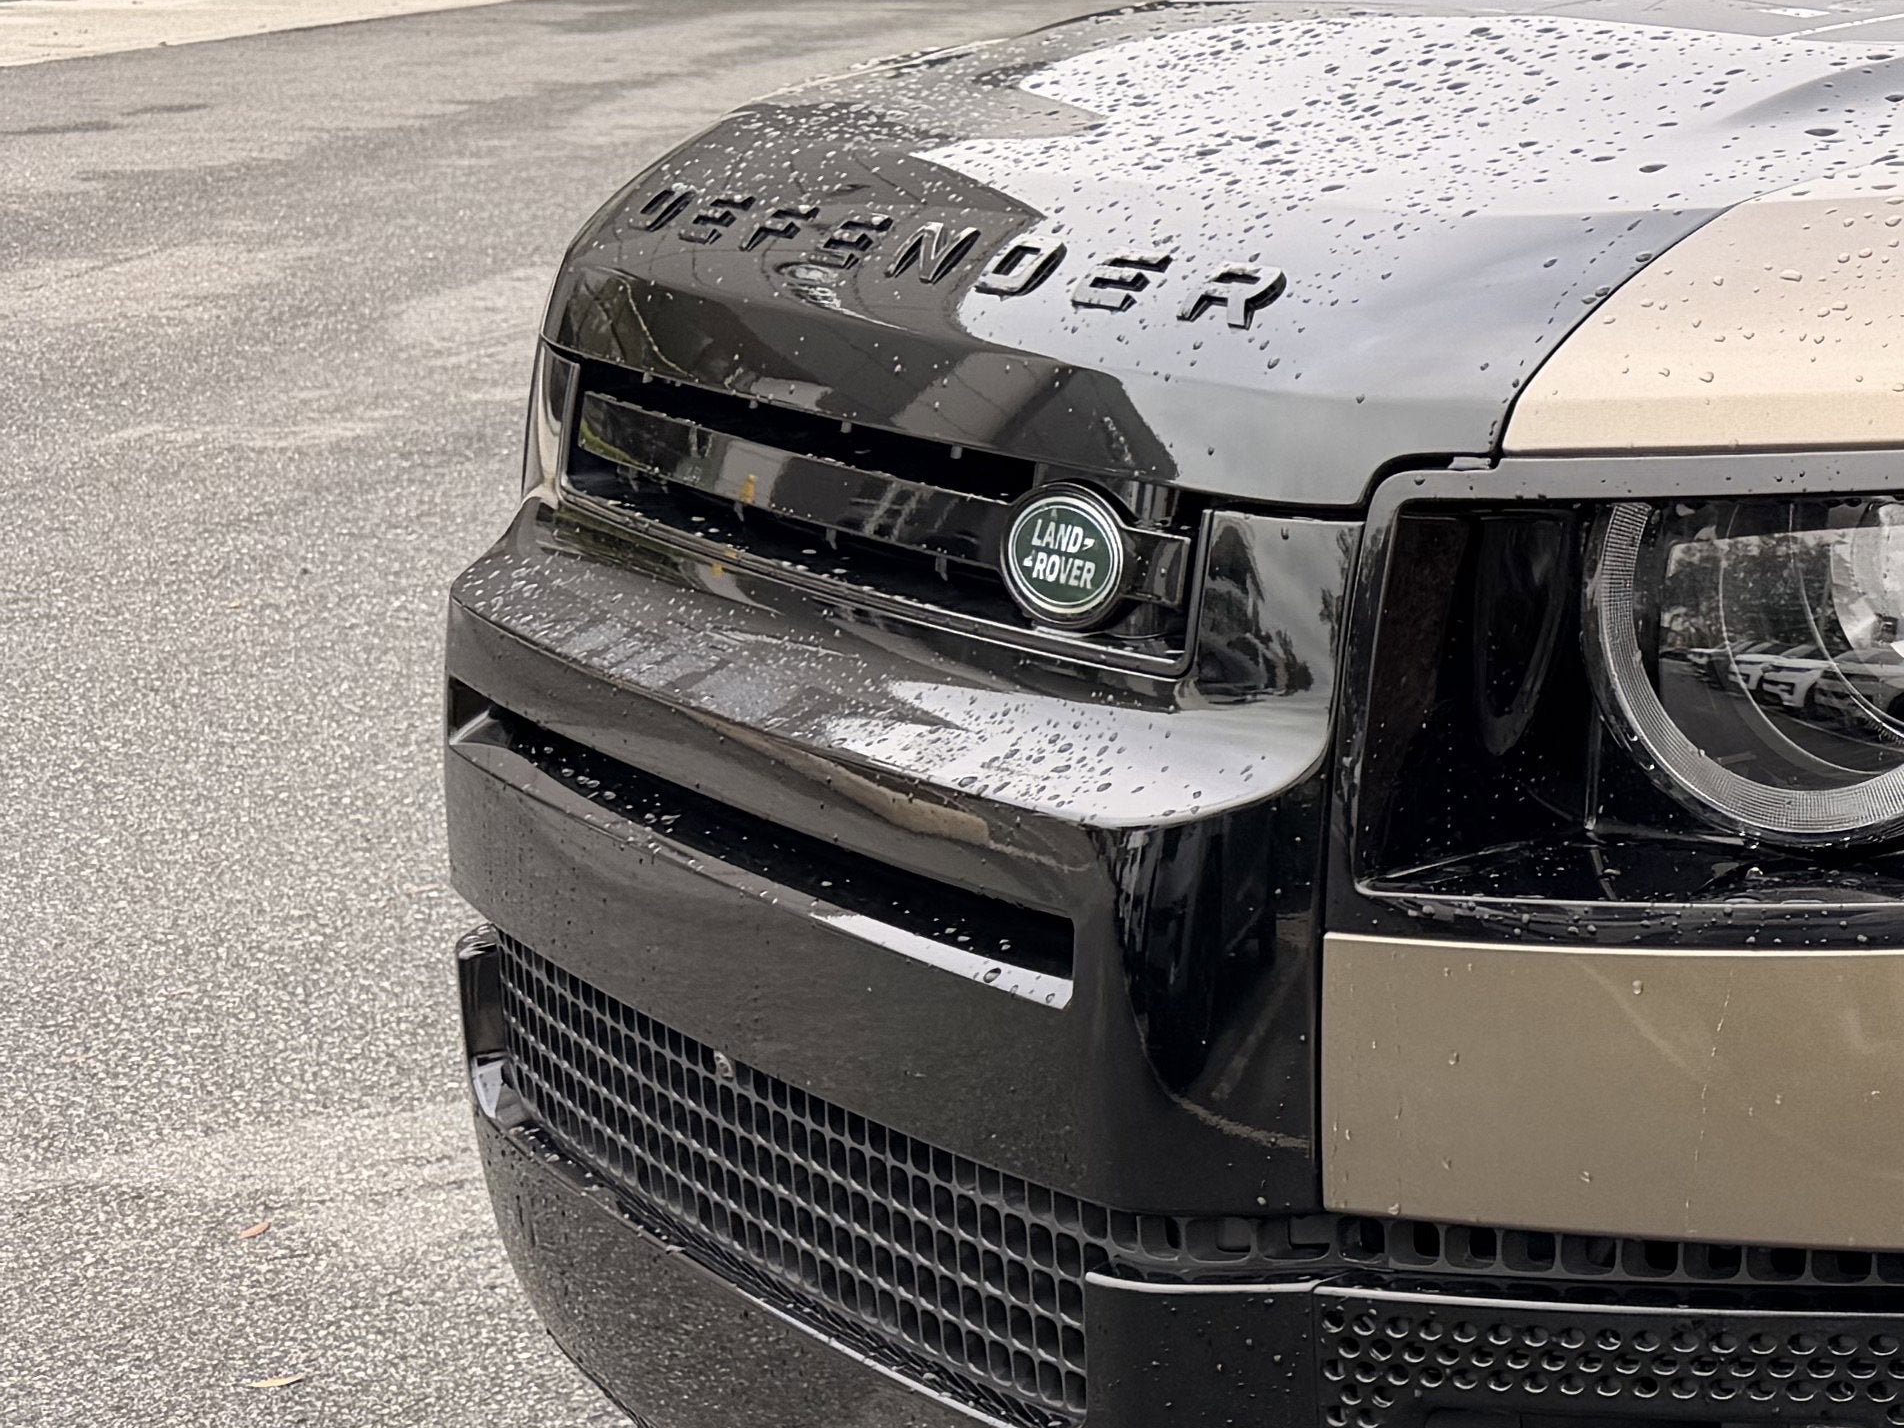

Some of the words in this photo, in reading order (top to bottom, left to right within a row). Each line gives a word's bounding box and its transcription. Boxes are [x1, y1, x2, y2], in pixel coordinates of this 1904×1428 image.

[628, 182, 1288, 332] DEFENDER
[1031, 518, 1084, 554] LAND
[1031, 551, 1096, 590] ROVER
